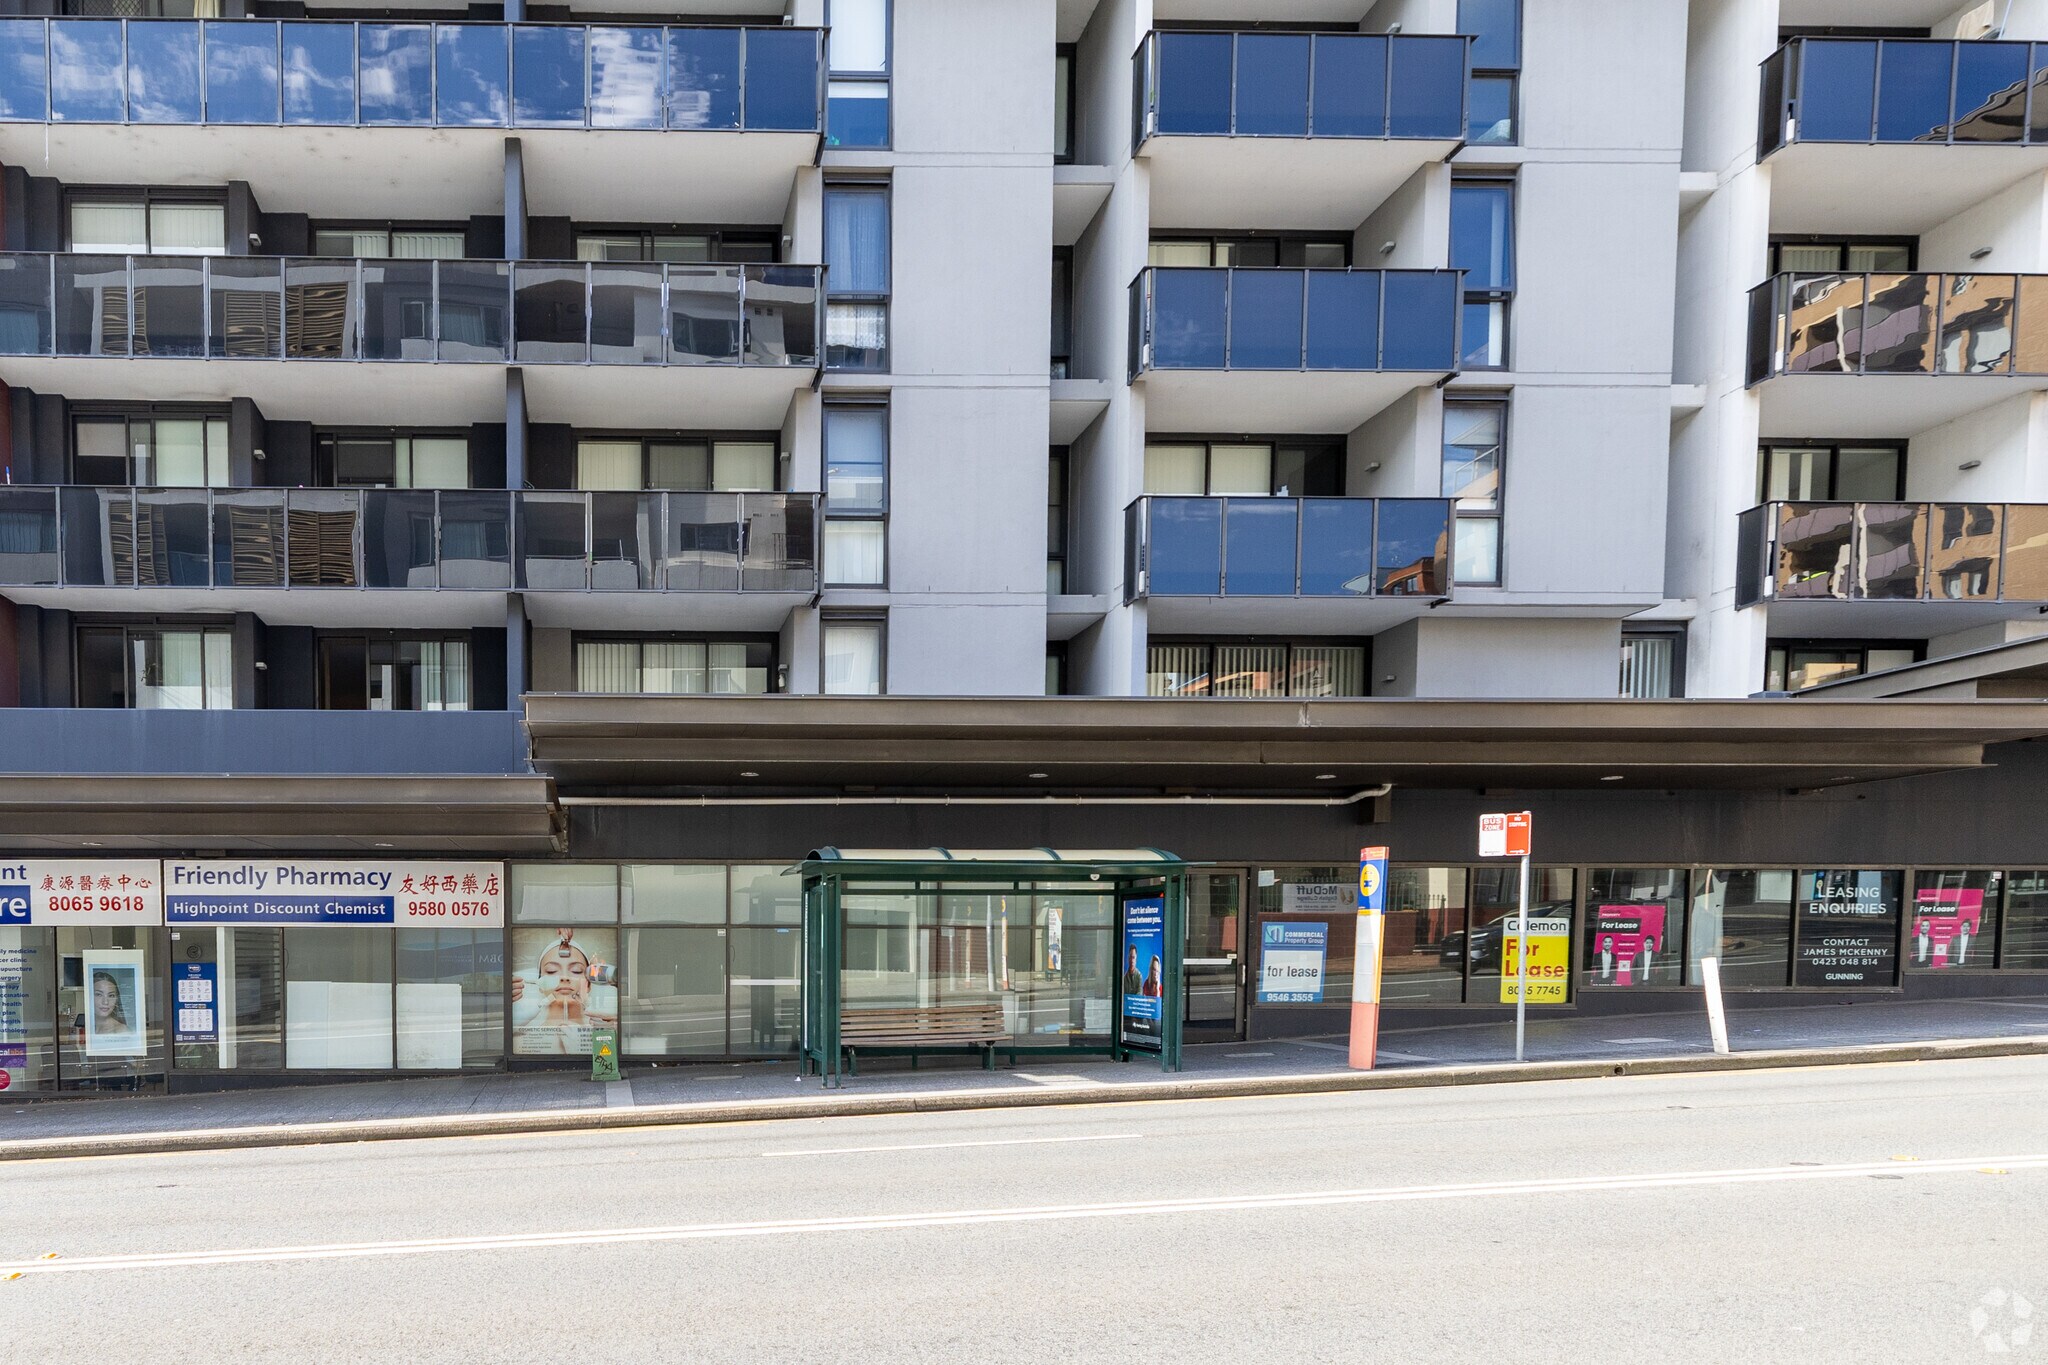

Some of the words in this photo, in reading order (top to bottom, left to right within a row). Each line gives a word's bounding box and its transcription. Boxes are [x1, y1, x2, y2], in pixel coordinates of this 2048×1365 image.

[40, 874, 152, 892] 康源醫療中心
[174, 865, 268, 890] Friendly
[276, 865, 392, 891] Pharmacy
[398, 873, 499, 896] 友好西藥店
[1818, 887, 1880, 898] LEASING
[0, 897, 27, 917] re
[49, 896, 93, 911] 8065
[99, 896, 144, 911] 9618
[173, 902, 249, 916] Highpoint
[254, 902, 320, 914] Discount
[325, 902, 386, 915] Chemist
[408, 901, 446, 916] 9580
[451, 901, 489, 916] 0576
[1809, 903, 1887, 914] ENQUIRIES
[1920, 905, 1932, 913] For
[1933, 905, 1956, 913] Lease
[1823, 938, 1870, 946] CONTACT
[1803, 948, 1836, 956] JAMES
[1839, 948, 1888, 956] MCKENNY
[1812, 958, 1837, 966] 0423
[1840, 958, 1859, 966] 048
[1861, 958, 1878, 966] 814
[1267, 965, 1283, 977] for
[1287, 965, 1318, 977] lease
[1507, 985, 1533, 995] 805
[1536, 986, 1561, 995] 7745
[1266, 993, 1290, 1002] 9546
[1291, 993, 1314, 1002] 3555
